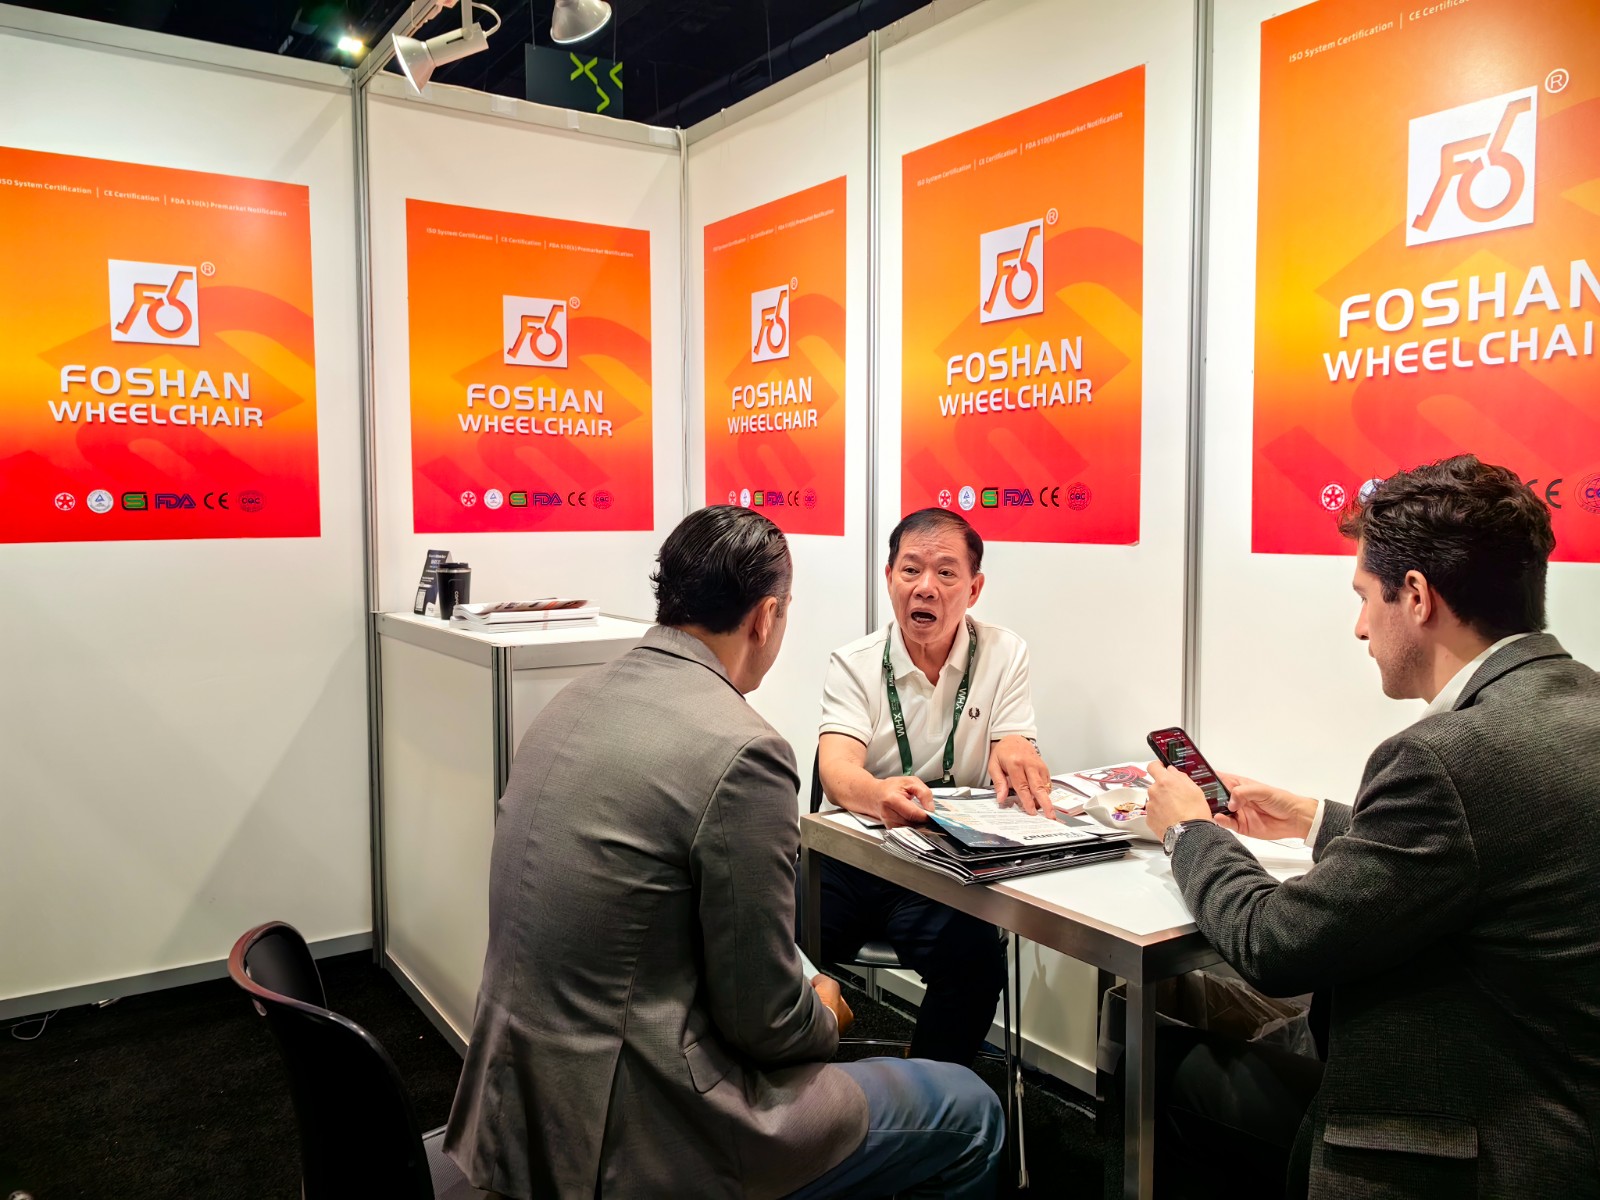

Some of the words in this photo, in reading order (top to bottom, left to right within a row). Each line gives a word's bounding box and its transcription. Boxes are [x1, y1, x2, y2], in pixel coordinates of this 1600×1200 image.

[1289, 51, 1303, 63] ISO
[1305, 41, 1336, 57] System
[1337, 20, 1394, 46] Certification
[1408, 11, 1421, 21] CE
[942, 163, 972, 178] Certification
[985, 147, 1018, 164] Certification
[1025, 142, 1037, 150] FDA
[1055, 124, 1087, 140] Premarket
[1086, 112, 1124, 129] Notification
[14, 179, 43, 190] System
[44, 183, 92, 195] Certification
[103, 189, 113, 197] CE
[114, 191, 160, 203] Certification
[210, 202, 246, 213] Premarket
[247, 206, 288, 217] Notification
[1338, 258, 1600, 338] FOSHAN
[946, 336, 1082, 386] FOSHAN
[1322, 320, 1593, 382] WHEELCHAI
[60, 364, 251, 401] FOSHAN
[466, 383, 604, 414] FOSHAN
[732, 376, 812, 410] FOSHAN
[938, 378, 1093, 417] WHEELCHAIR
[48, 400, 264, 428] WHEELCHAIR
[457, 413, 613, 437] WHEELCHAIR
[727, 408, 818, 434] WHEELCHAIR
[155, 493, 196, 510] FDA
[533, 492, 563, 507] FDA
[1003, 488, 1035, 507] FDA
[955, 687, 967, 711] WHX
[893, 712, 906, 737] WHX
